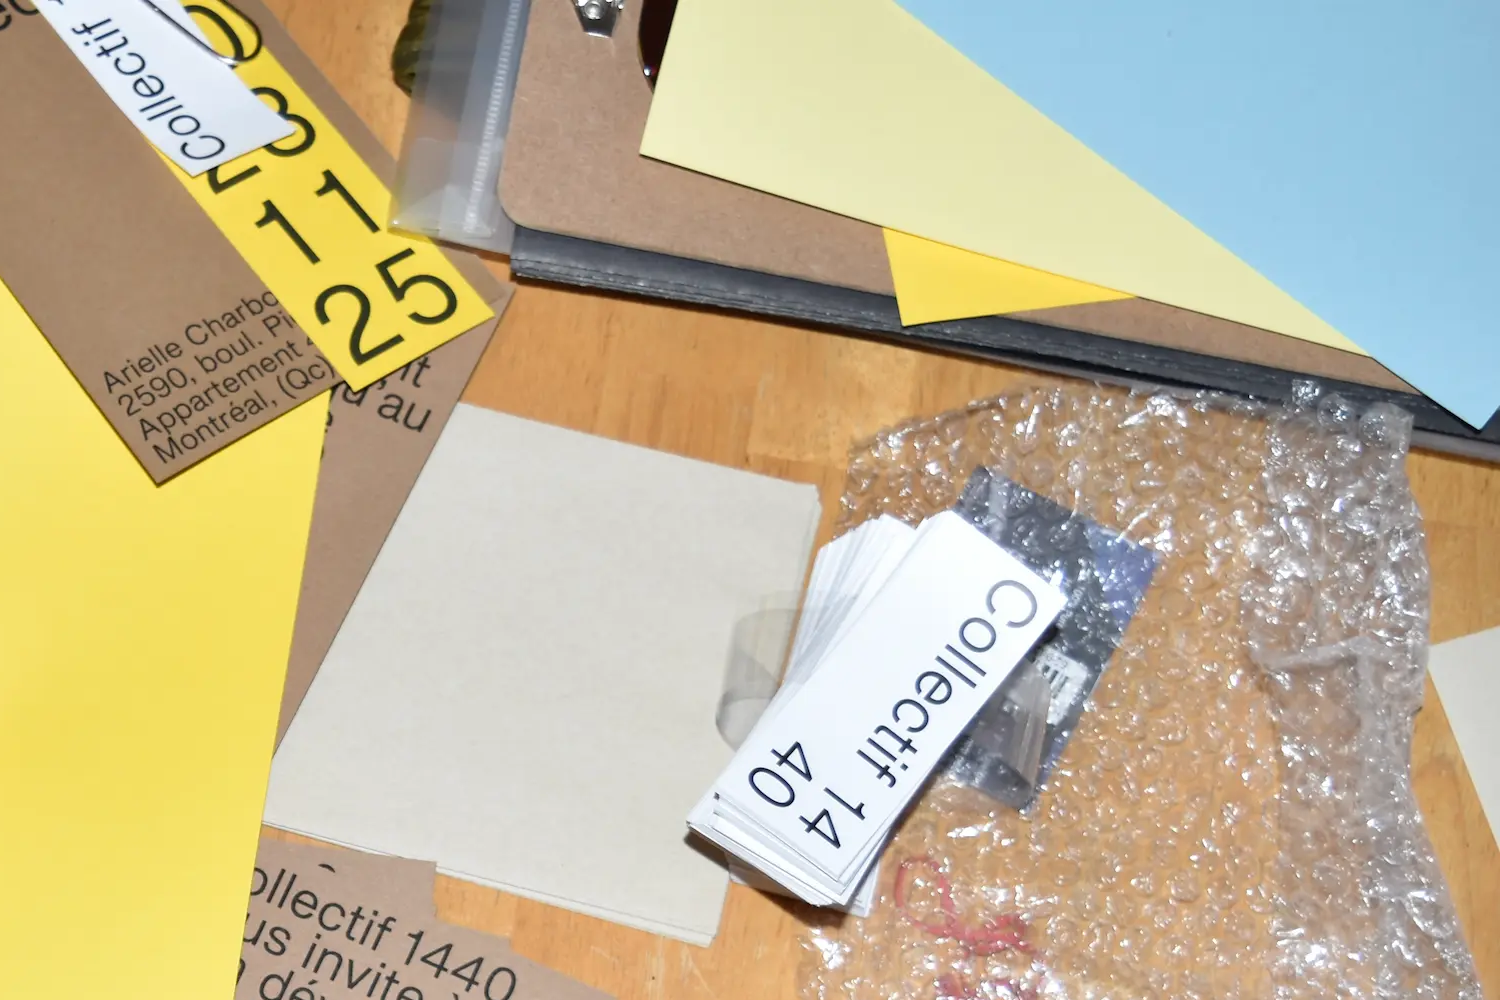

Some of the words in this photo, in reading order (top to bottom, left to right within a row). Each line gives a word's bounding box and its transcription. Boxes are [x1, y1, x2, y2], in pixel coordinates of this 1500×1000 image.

[71, 17, 225, 161] Collectif
[255, 169, 381, 265] 11
[313, 246, 459, 367] 25
[103, 339, 183, 393] Arielle
[117, 366, 197, 417] 2590,
[196, 330, 264, 374] boul.
[263, 311, 297, 337] Pi
[138, 341, 303, 441] Appartement
[152, 387, 278, 464] Montréal,
[277, 354, 337, 400] (Qc)
[856, 578, 1038, 788] Collectif
[747, 738, 813, 807] 40
[797, 786, 868, 850] 14
